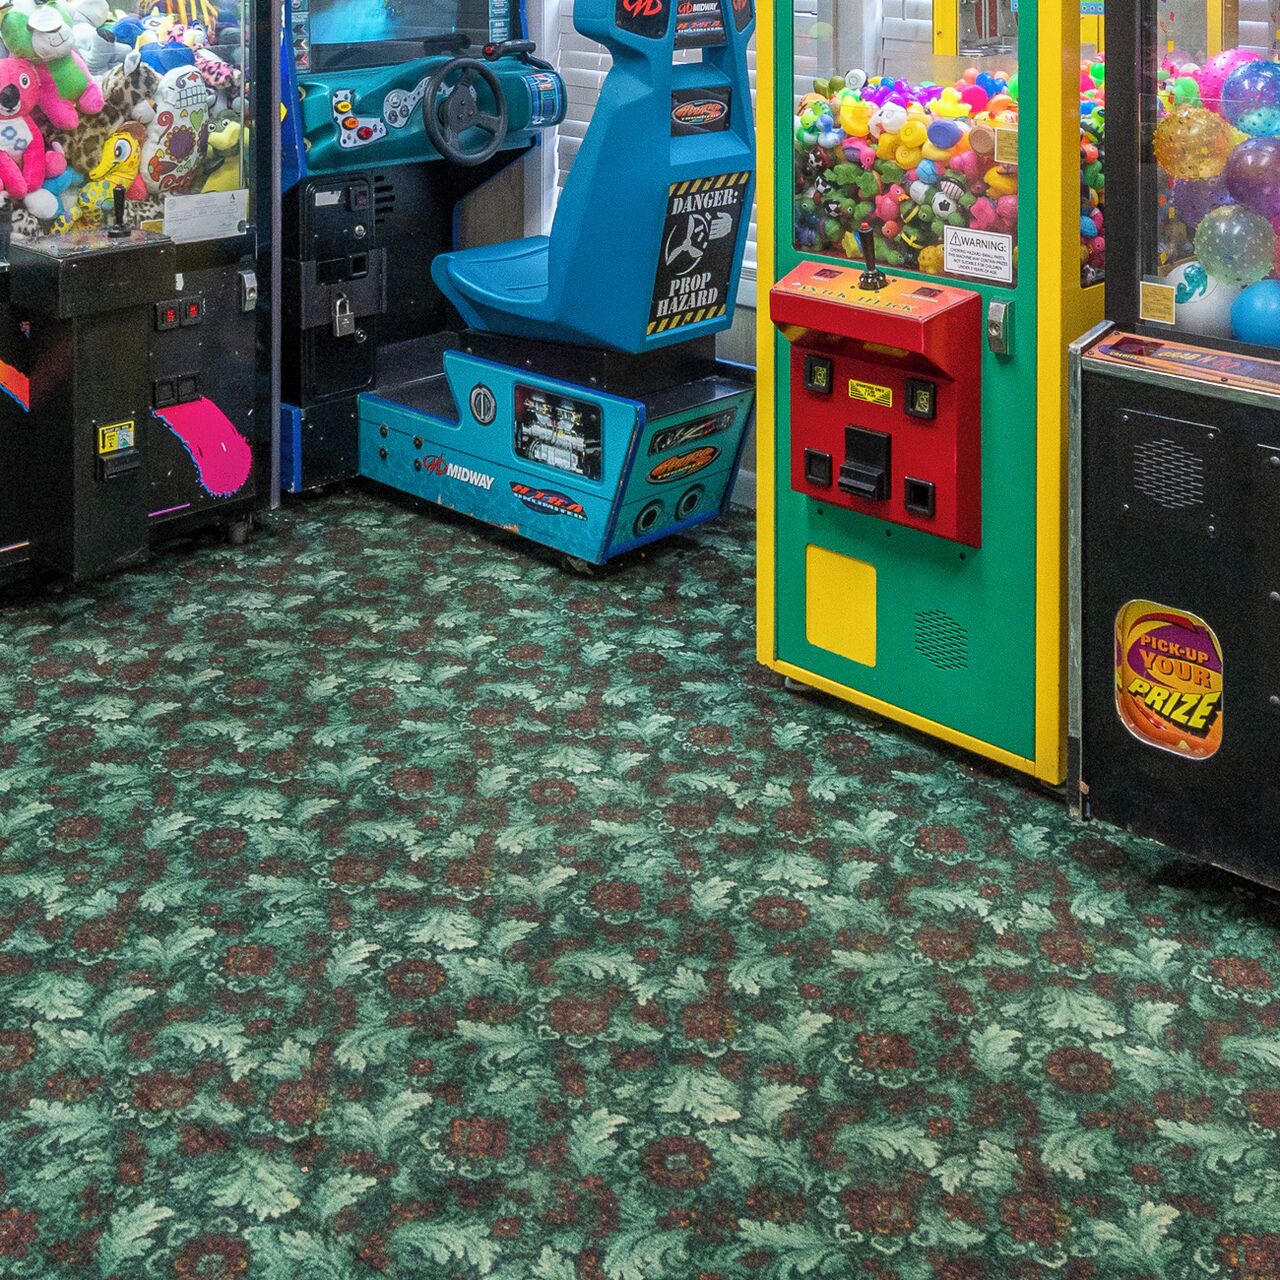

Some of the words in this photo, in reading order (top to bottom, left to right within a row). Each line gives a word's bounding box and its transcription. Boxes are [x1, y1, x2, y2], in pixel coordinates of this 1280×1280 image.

[693, 2, 718, 12] MIDWAY
[671, 188, 738, 215] DANGER:
[961, 236, 1007, 253] WARNING:
[669, 272, 711, 298] PROP
[656, 287, 719, 318] HAZARD
[446, 463, 495, 491] MIDWAY
[1140, 634, 1209, 664] PICK-UP
[1139, 648, 1211, 689] YOUR
[1128, 678, 1221, 729] PRIZE
